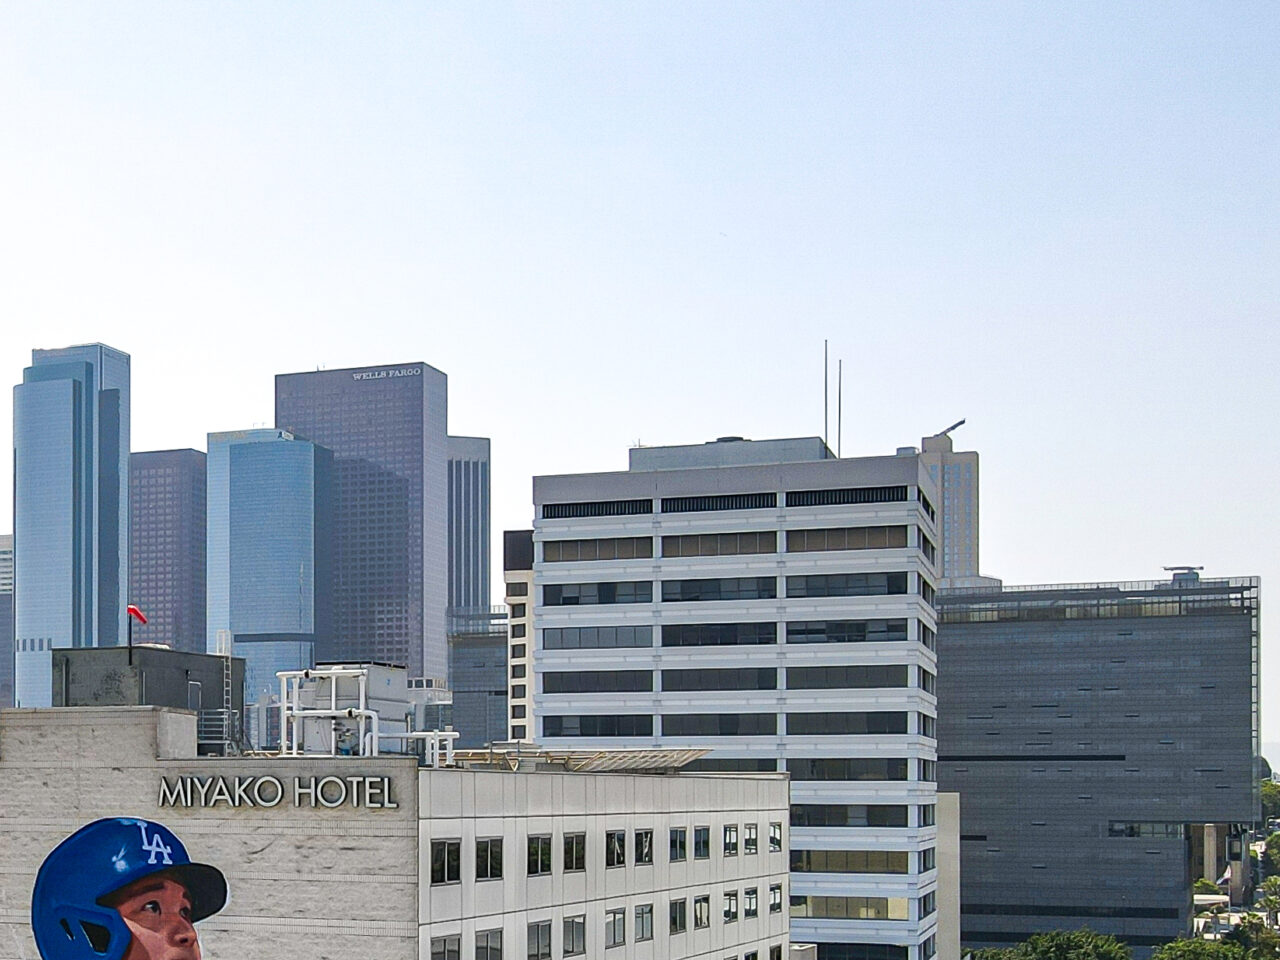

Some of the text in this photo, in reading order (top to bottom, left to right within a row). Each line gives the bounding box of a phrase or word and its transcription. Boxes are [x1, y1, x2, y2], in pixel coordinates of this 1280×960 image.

[353, 368, 421, 381] WELLS FARGO
[158, 775, 399, 808] MIYAKO HOTEL
[137, 821, 173, 864] LA
